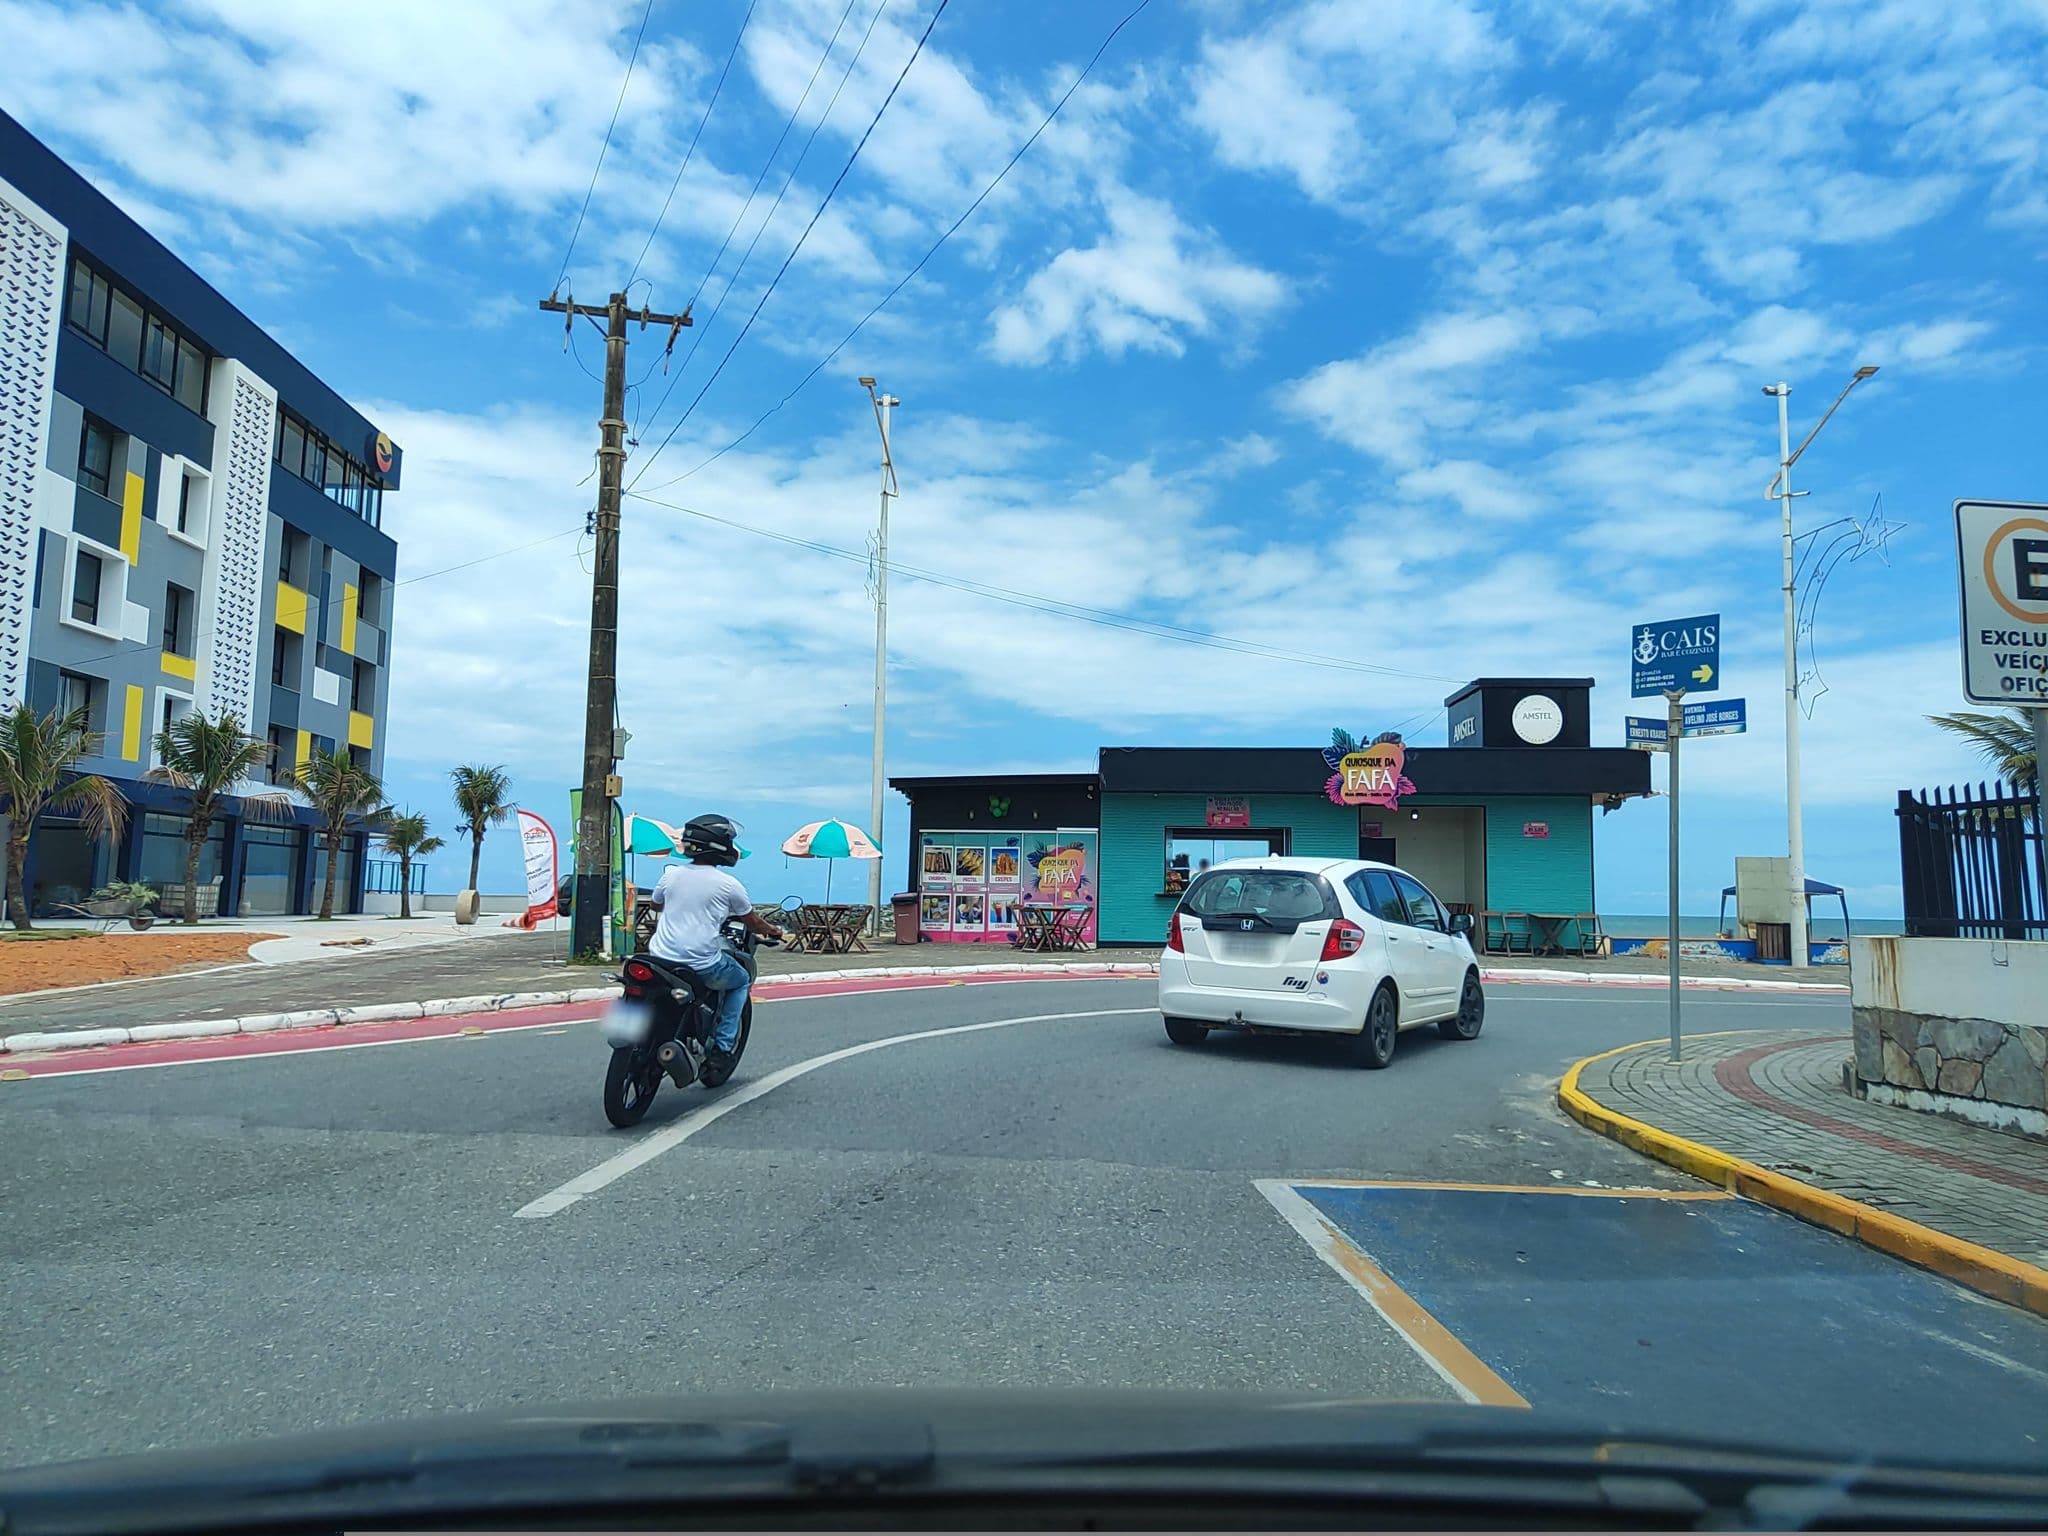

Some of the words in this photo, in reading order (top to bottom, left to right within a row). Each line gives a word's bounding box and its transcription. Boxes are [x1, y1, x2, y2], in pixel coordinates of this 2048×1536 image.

[1660, 625, 1716, 651] CAIS
[1681, 646, 1714, 656] COZINHA
[1684, 705, 1706, 714] AVENIDA
[1522, 712, 1552, 720] AMSTEL
[1684, 713, 1705, 725] AVELINO
[1706, 710, 1718, 722] JOSÉ
[1719, 710, 1739, 721] BORGES
[1453, 716, 1475, 744] AMSTEL
[1630, 728, 1649, 738] ERNESTO
[1345, 758, 1382, 767] QUIOSQUE
[1384, 758, 1396, 767] DA
[1347, 767, 1396, 791] FAFÁ
